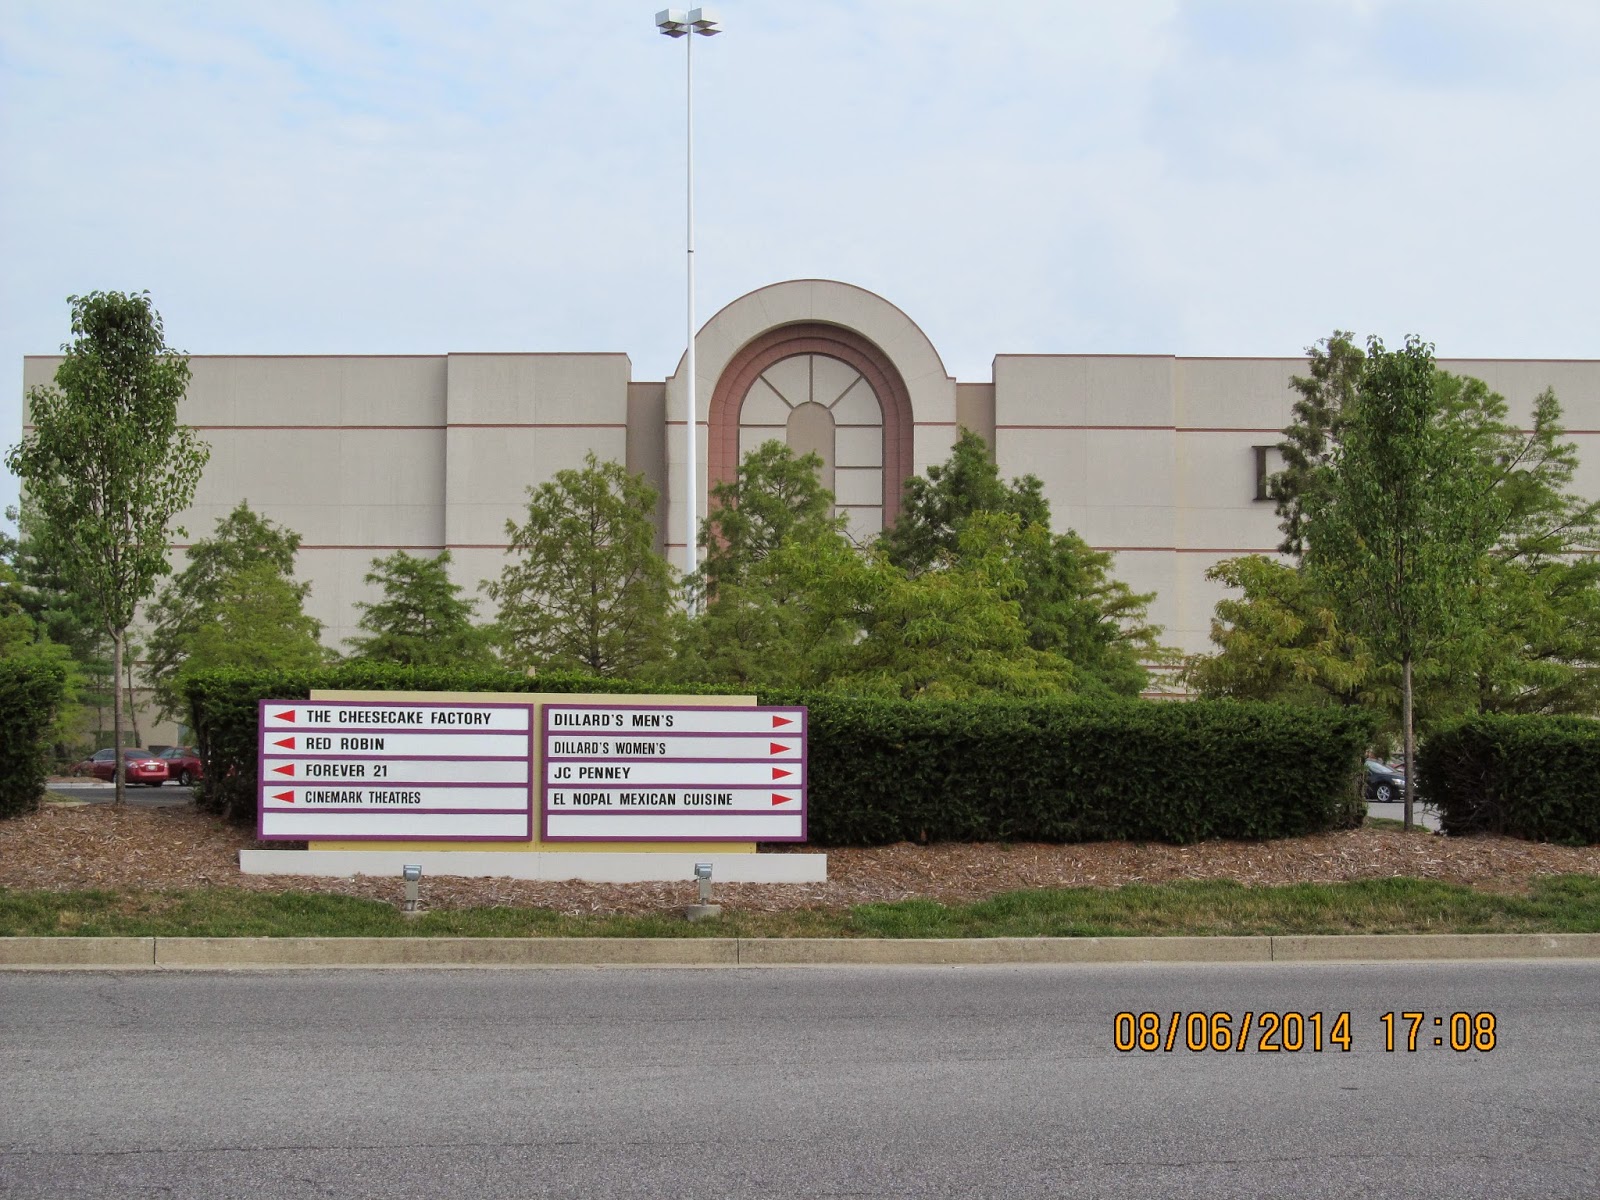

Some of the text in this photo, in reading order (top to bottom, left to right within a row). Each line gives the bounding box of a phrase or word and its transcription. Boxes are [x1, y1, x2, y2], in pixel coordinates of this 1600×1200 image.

[306, 709, 492, 725] THE CHEESECAKE FACTORY
[554, 713, 674, 728] DILLARD'S MEN'S
[306, 737, 385, 751] RED ROBIN
[554, 741, 666, 755] DILLARD'S WOMEN'S
[305, 763, 388, 778] FOREVER 21
[553, 766, 631, 780] JC PENNEY
[305, 790, 421, 805] CINEMARK THEATRES
[553, 792, 733, 806] EL NOPAL MEXICAN CUISINE
